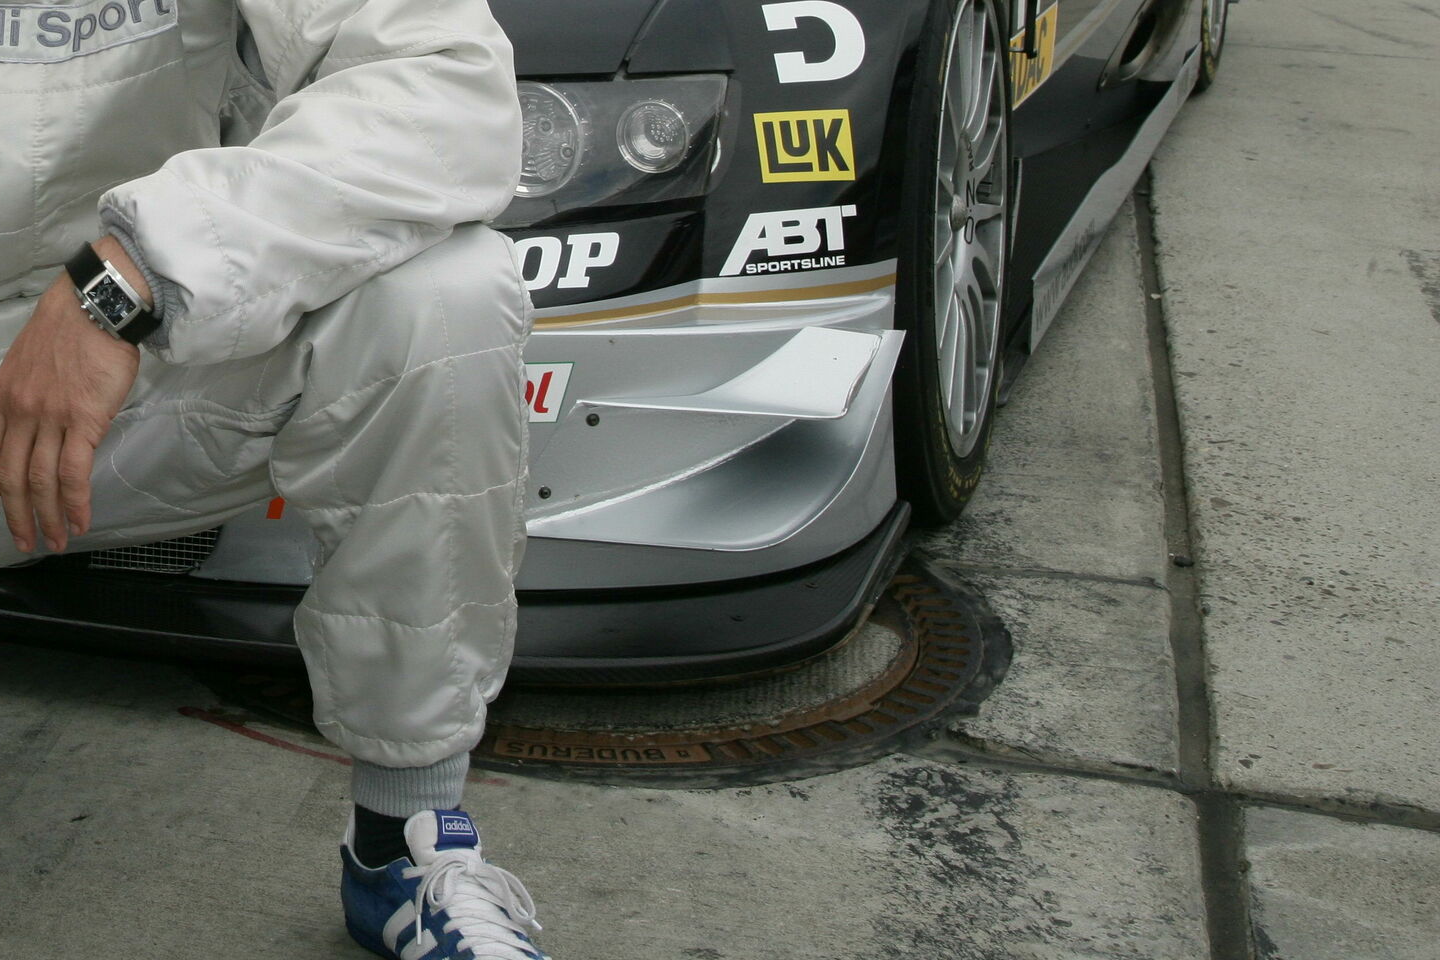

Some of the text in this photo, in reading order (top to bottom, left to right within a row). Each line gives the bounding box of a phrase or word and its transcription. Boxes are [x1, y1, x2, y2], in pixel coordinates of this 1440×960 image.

[762, 118, 850, 174] LUK
[719, 204, 857, 277] ABT
[745, 255, 846, 275] SPORTSLINE
[506, 742, 666, 761] BUDERUS
[445, 821, 471, 831] adidas
